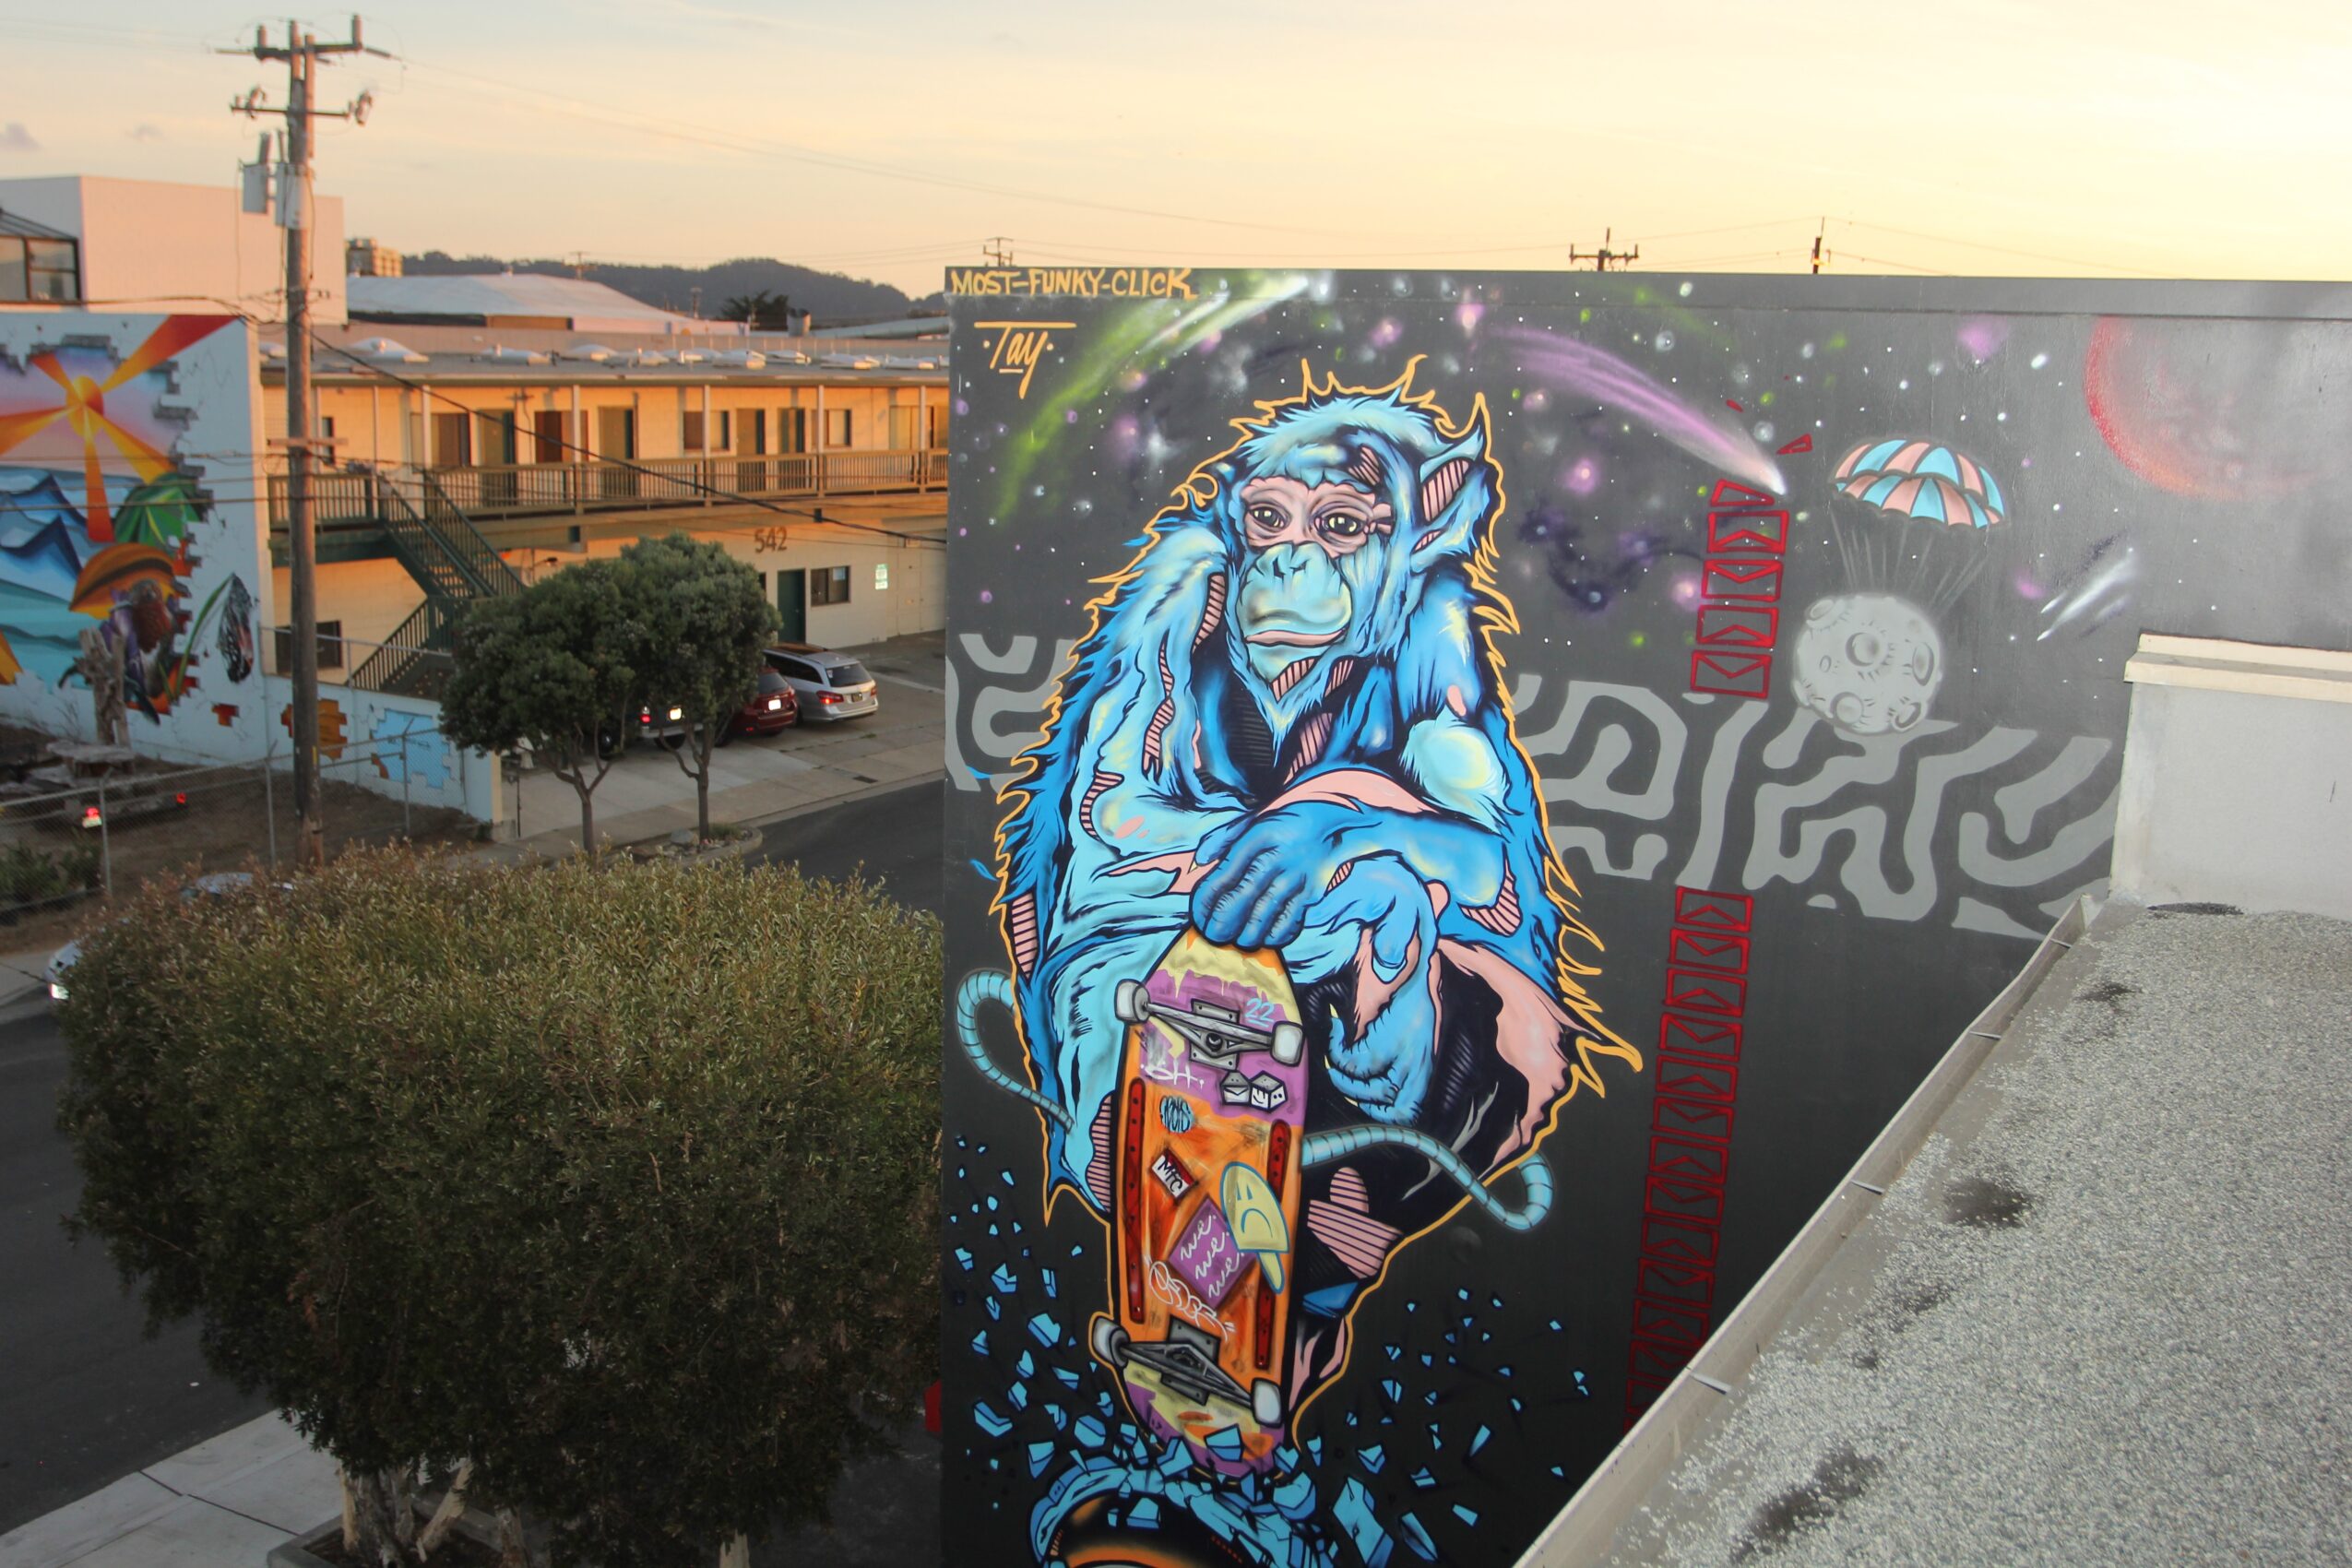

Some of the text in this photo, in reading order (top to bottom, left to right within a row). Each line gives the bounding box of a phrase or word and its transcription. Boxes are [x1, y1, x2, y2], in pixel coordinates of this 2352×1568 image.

[974, 321, 1076, 399] Tay
[754, 526, 788, 553] 542
[1244, 998, 1276, 1024] 22
